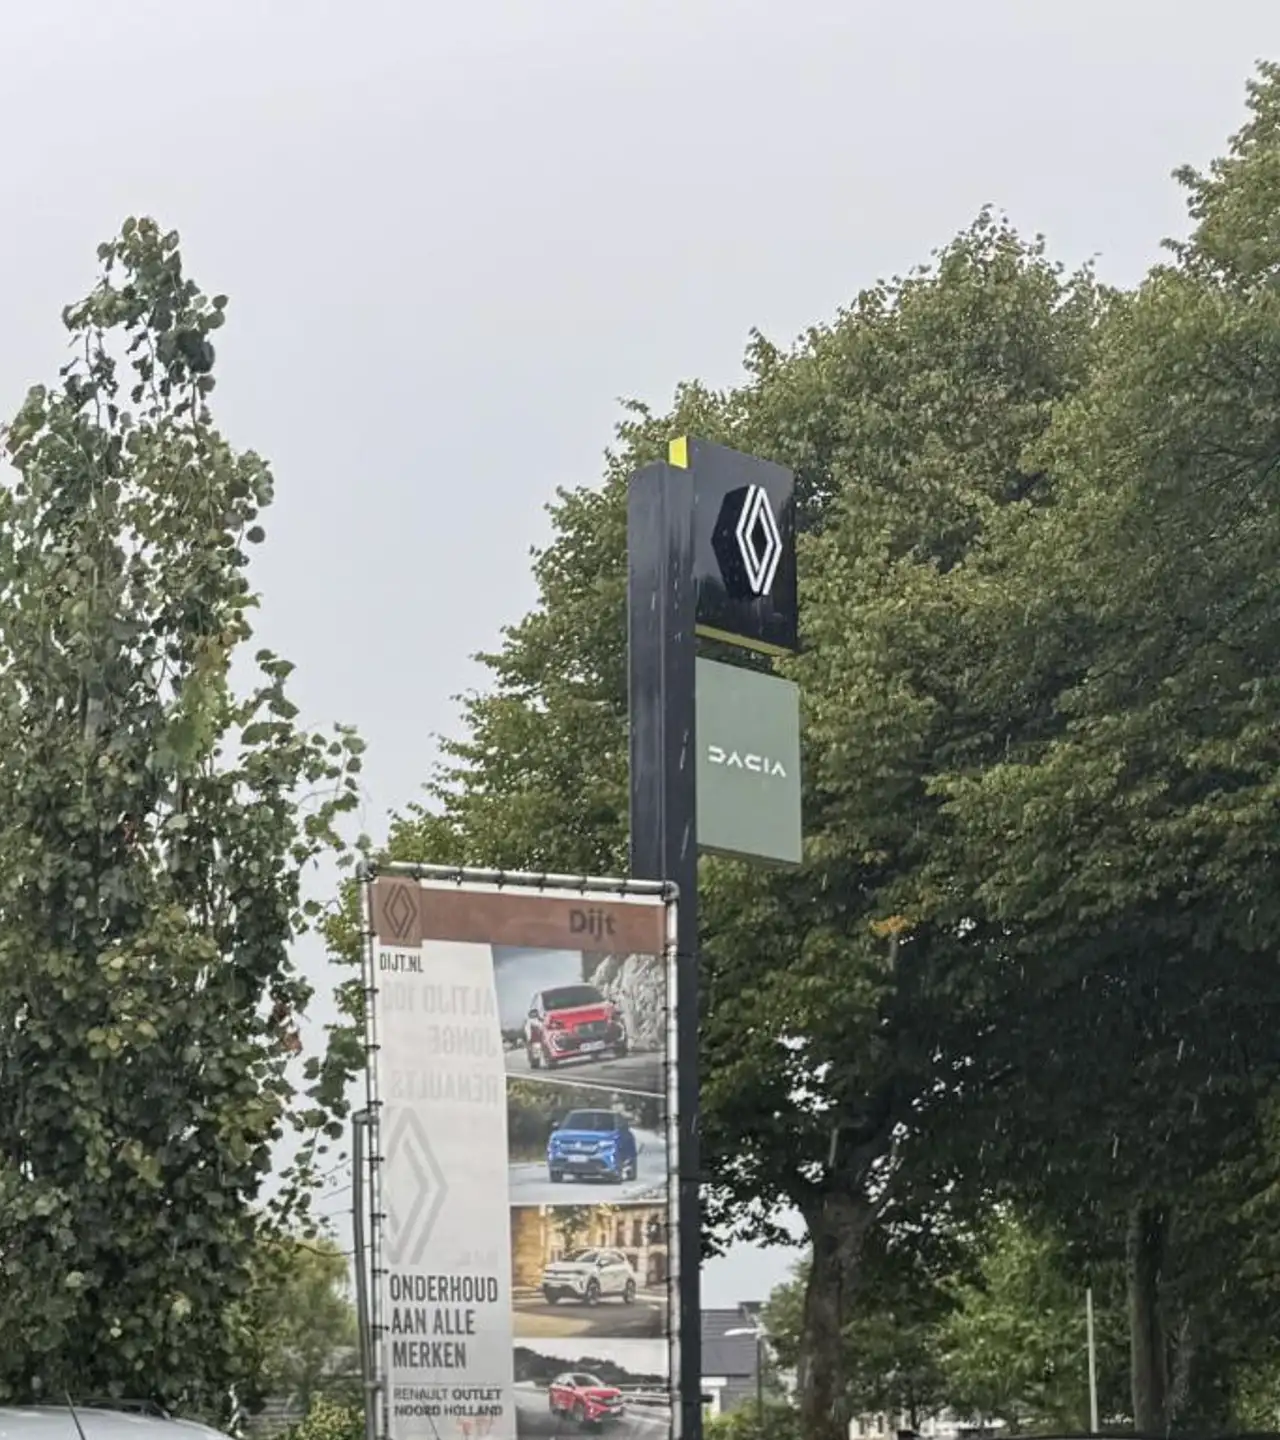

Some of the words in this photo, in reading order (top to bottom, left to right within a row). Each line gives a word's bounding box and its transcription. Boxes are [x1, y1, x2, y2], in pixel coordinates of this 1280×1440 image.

[708, 745, 786, 777] DACIA
[569, 908, 616, 941] Dijt
[379, 952, 424, 973] DIJT.NL
[389, 1274, 498, 1302] ONDERHOUD
[391, 1307, 426, 1335] AAN
[433, 1308, 476, 1335] ALLE
[393, 1341, 467, 1369] MERKEN
[393, 1388, 448, 1401] RENAULT
[452, 1388, 503, 1401] OUTLET
[394, 1404, 441, 1416] NOORD
[444, 1404, 503, 1417] HOLLAND
